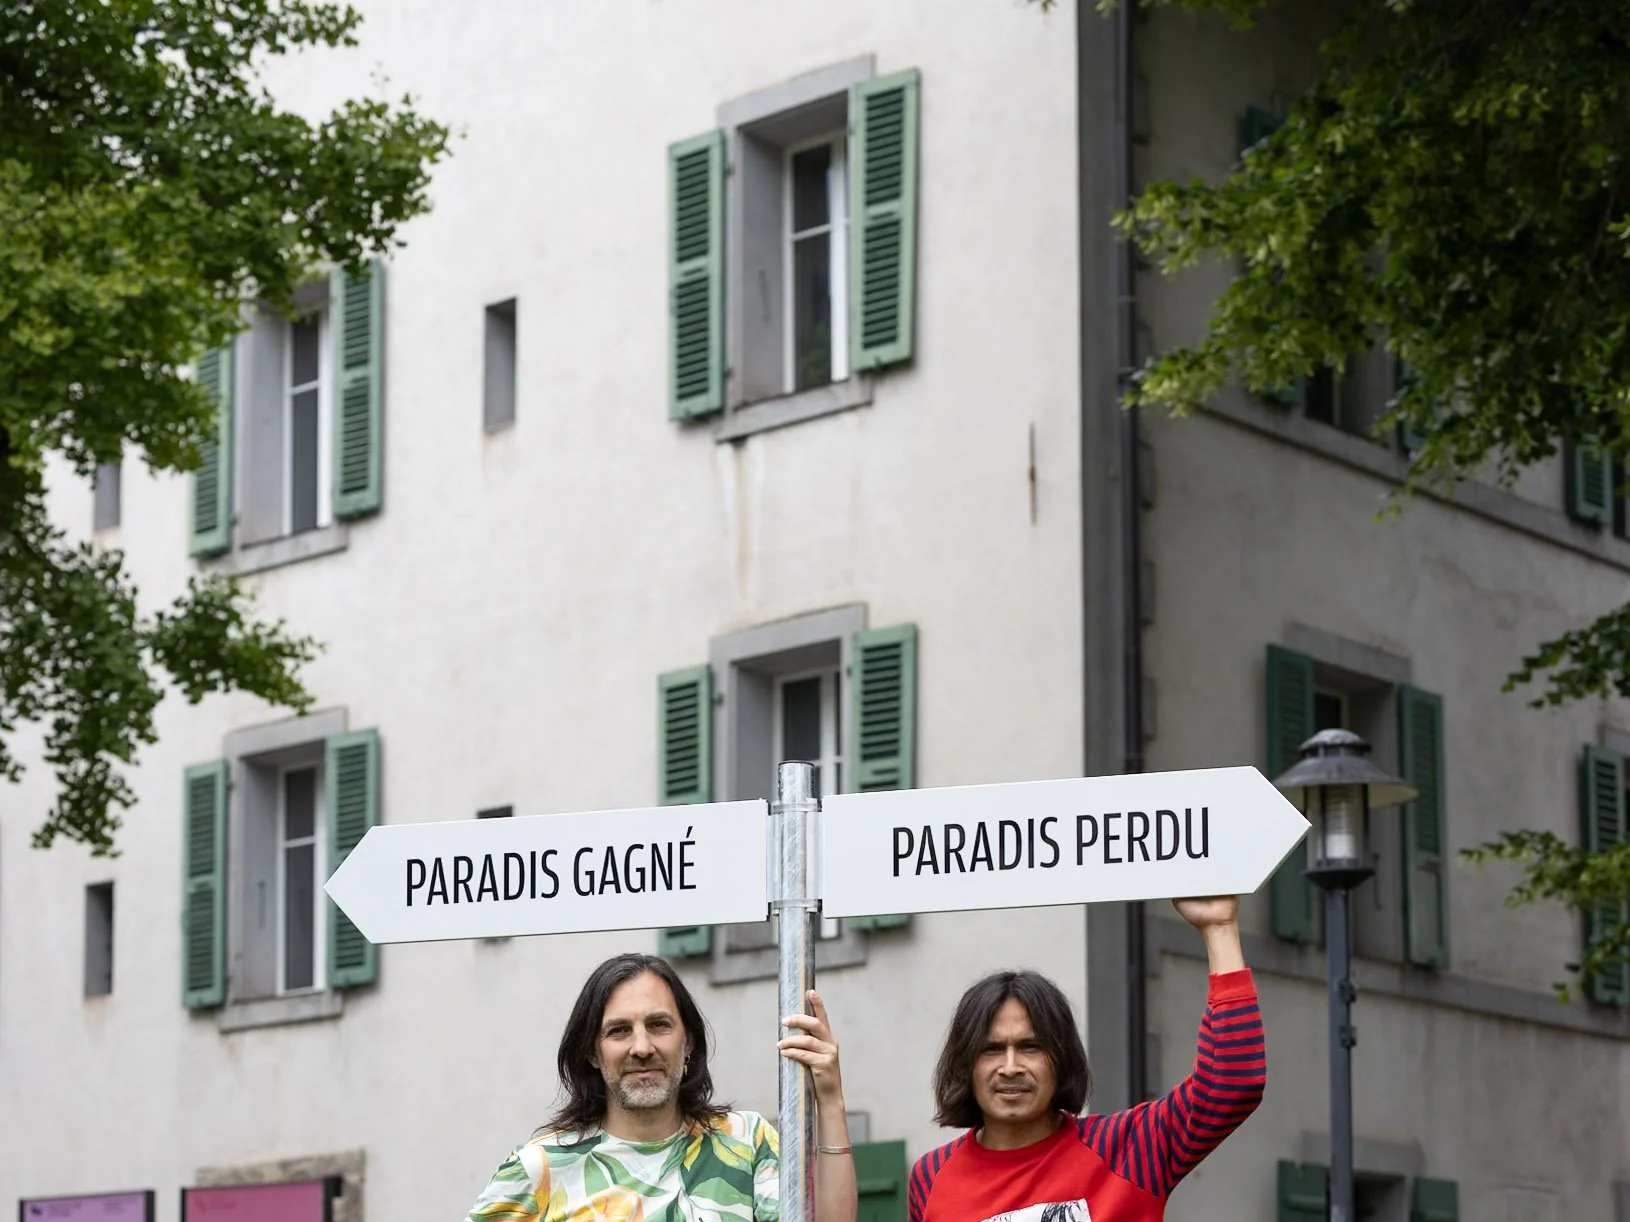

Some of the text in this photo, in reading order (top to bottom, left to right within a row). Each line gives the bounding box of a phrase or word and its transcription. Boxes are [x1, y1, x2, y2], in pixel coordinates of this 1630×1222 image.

[406, 825, 698, 907] PARADIS GAGNÉ
[892, 806, 1209, 878] PARADIS PERDU
